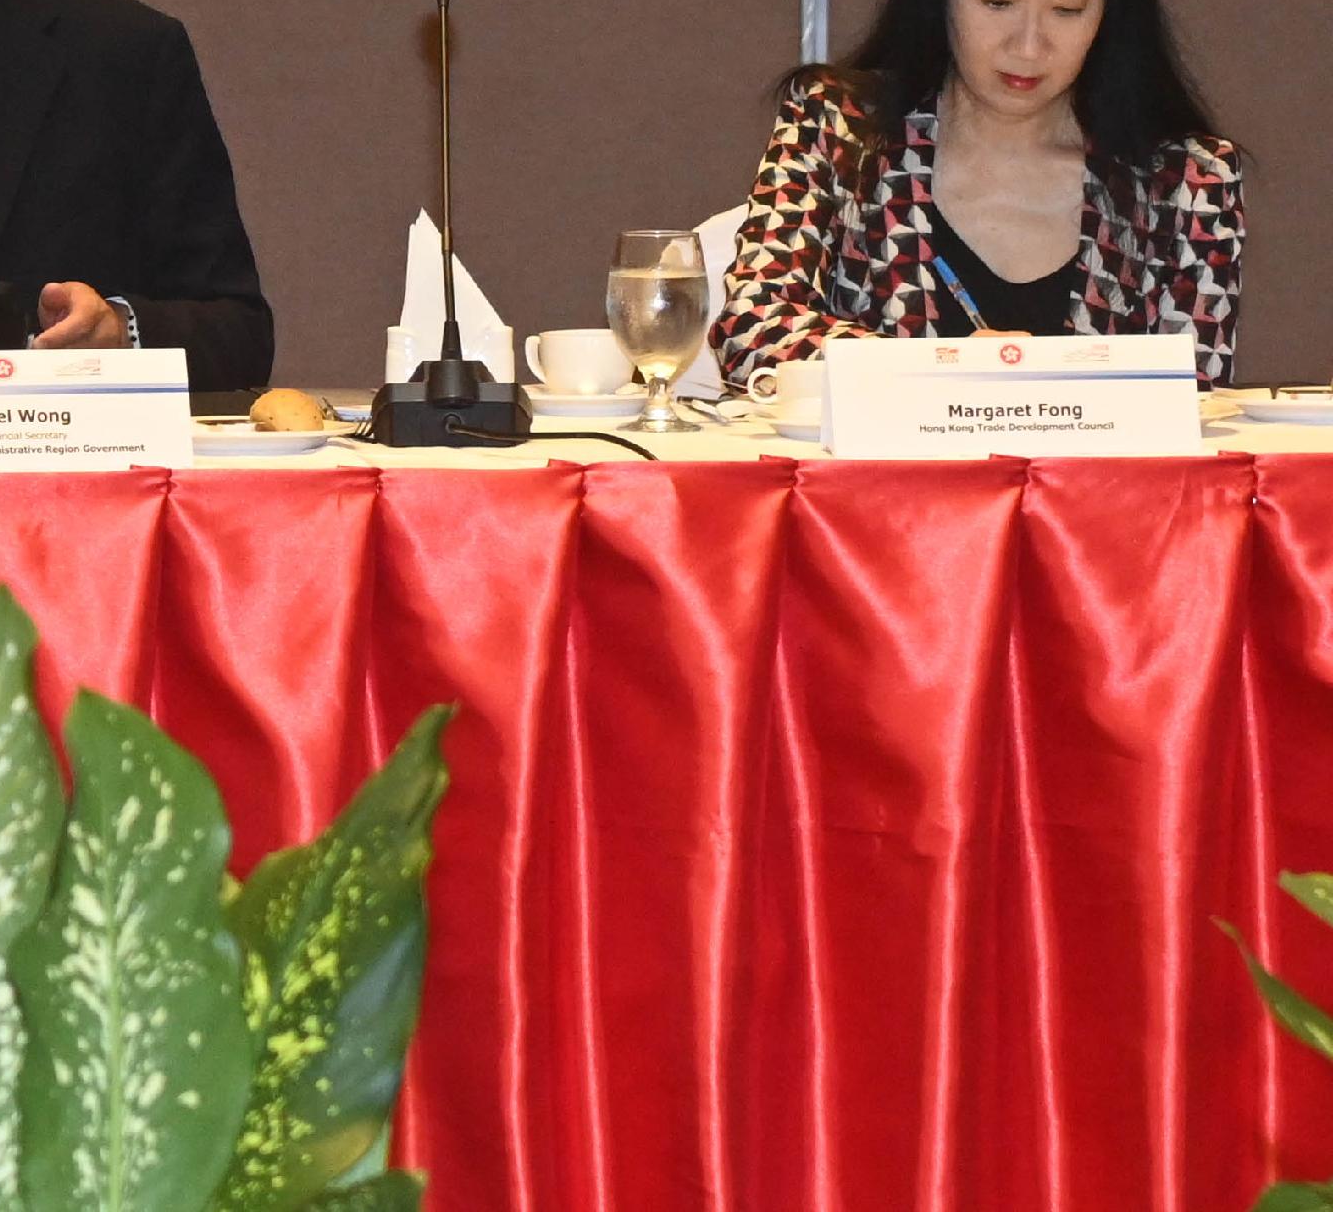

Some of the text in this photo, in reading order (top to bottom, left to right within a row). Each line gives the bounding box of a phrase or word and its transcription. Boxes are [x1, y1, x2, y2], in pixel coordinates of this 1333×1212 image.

[18, 409, 71, 425] Wong
[948, 404, 1083, 421] Margaret Fong
[920, 422, 1114, 433] Hong Kong Trade Development Council
[25, 432, 68, 441] Secretary
[45, 445, 79, 455] Region
[83, 443, 145, 454] Government
